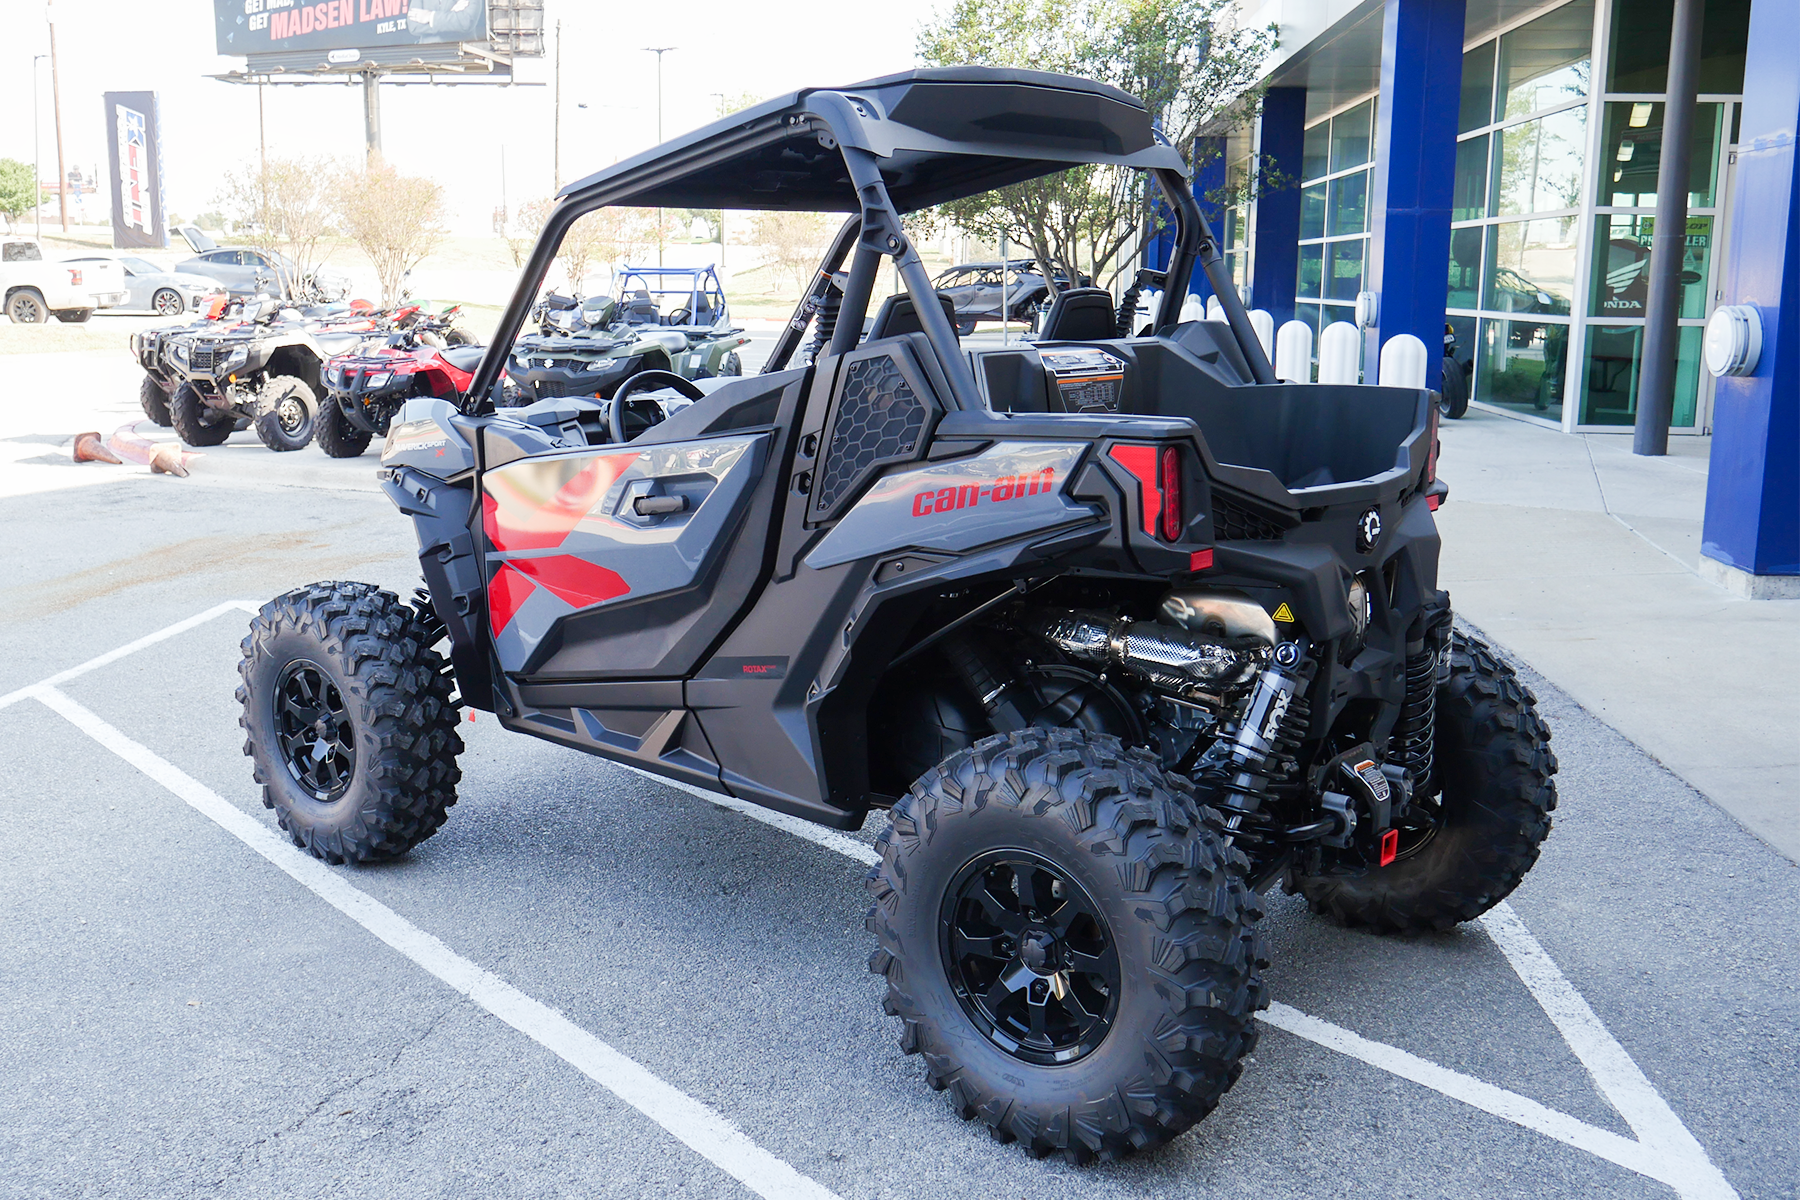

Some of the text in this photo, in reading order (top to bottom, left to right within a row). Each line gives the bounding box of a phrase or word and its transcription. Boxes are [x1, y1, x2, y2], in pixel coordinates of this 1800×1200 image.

[245, 0, 264, 15] GET
[249, 0, 408, 40] GET MADSEN LAW!
[376, 18, 407, 35] KYLE, TX
[1684, 235, 1707, 248] LER
[1603, 300, 1642, 309] NDA
[911, 466, 1056, 518] can-am
[742, 664, 767, 674] ROTAX
[1262, 688, 1293, 742] FOX
